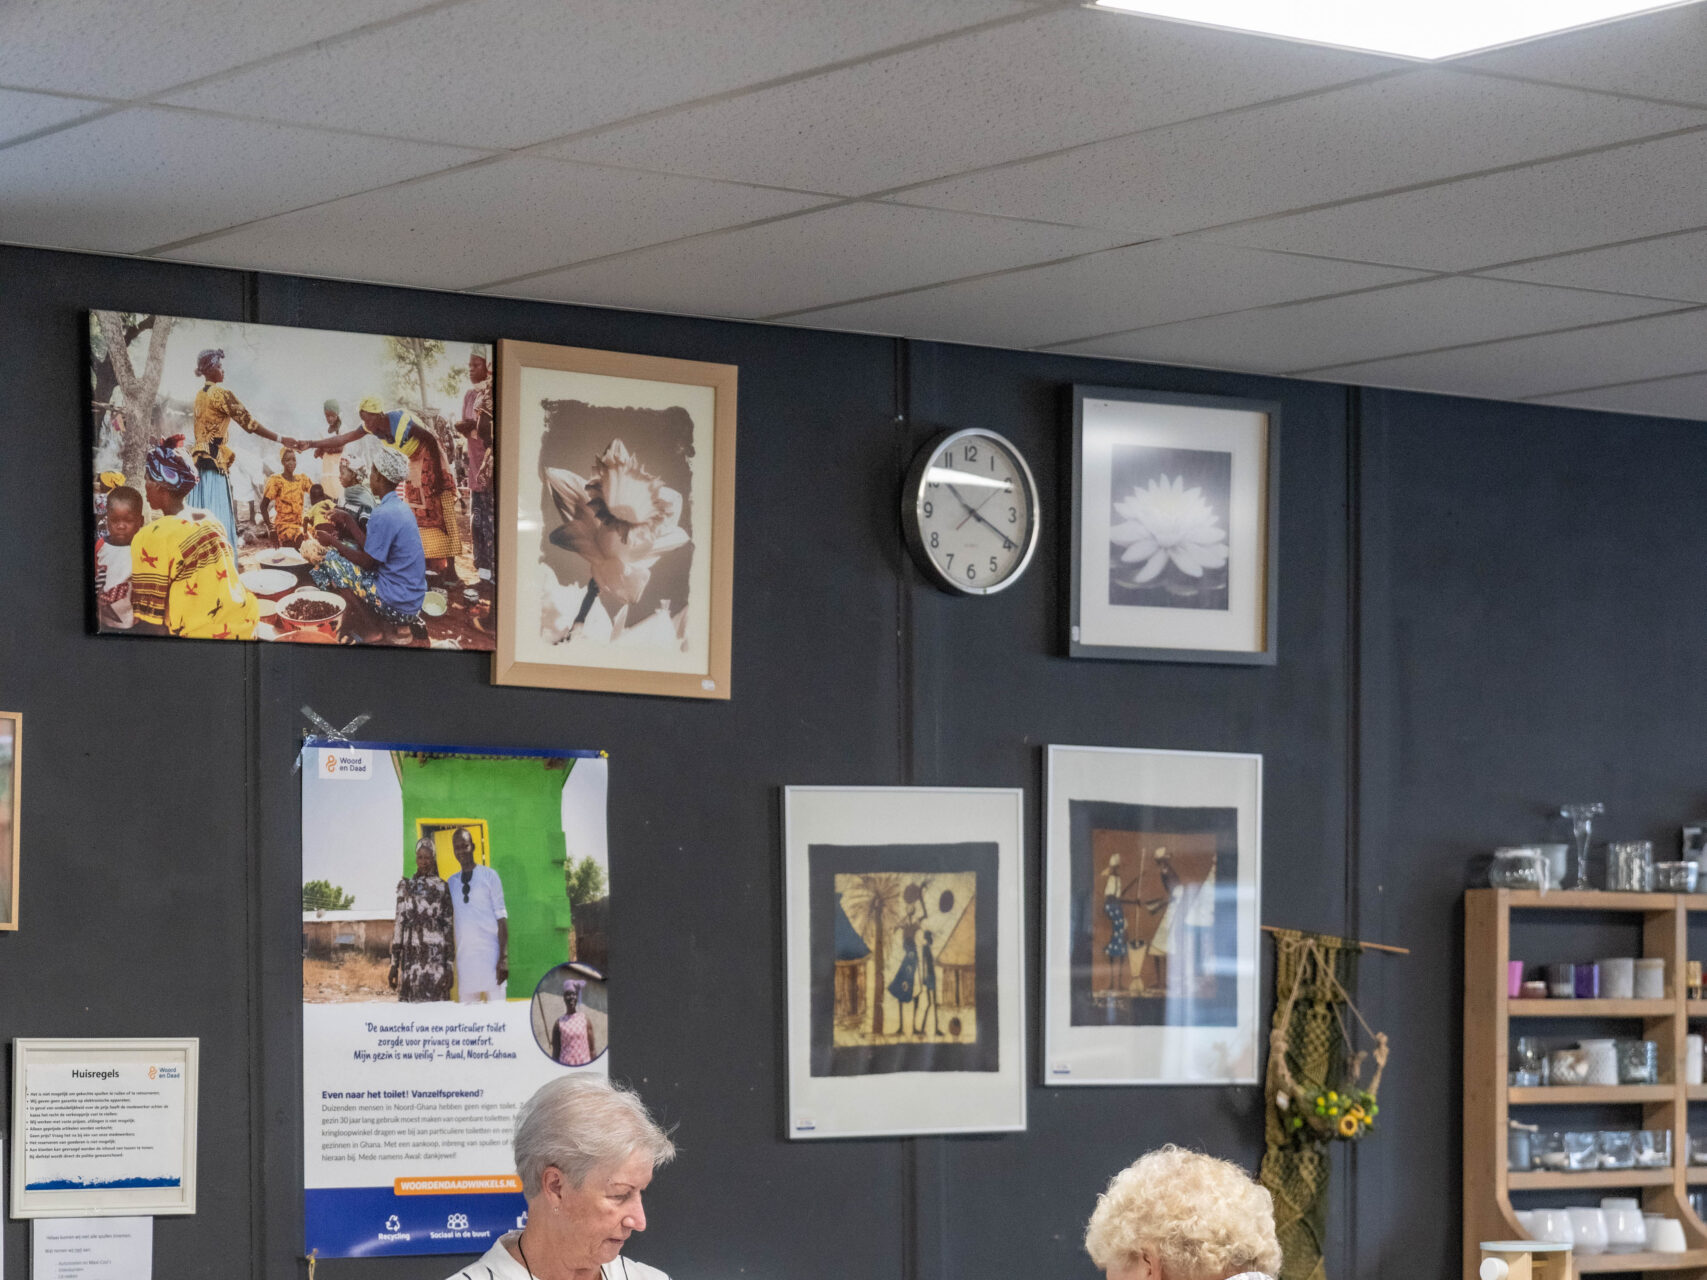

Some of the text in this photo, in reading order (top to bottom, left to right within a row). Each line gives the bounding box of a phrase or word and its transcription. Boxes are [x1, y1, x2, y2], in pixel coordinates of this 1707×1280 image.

[944, 452, 953, 468] 11
[964, 446, 978, 462] 12
[991, 456, 994, 471] 1
[924, 501, 933, 518] 9
[1008, 507, 1017, 523] 3
[930, 532, 939, 548] 8
[946, 553, 955, 570] 7
[989, 556, 998, 572] 5
[966, 564, 976, 579] 6
[340, 757, 362, 765] Woord
[380, 1022, 415, 1033] aanschaf
[445, 1022, 484, 1034] particulier
[486, 1022, 506, 1032] toilet
[378, 1036, 403, 1048] zorgde
[405, 1038, 421, 1046] voor
[422, 1037, 450, 1048] privacy
[462, 1036, 494, 1046] comfort.
[353, 1050, 371, 1062] Mijn
[372, 1051, 393, 1062] gezin
[395, 1051, 401, 1059] is
[445, 1050, 465, 1060] Awal,
[71, 1069, 120, 1080] Huisregels
[322, 1091, 343, 1099] Even
[367, 1090, 381, 1099] het
[383, 1090, 409, 1099] toilet!
[411, 1089, 484, 1099] Vanzelfsprekend?
[400, 1179, 517, 1191] WOORDENDAADWINKELS.NL
[378, 1233, 411, 1241] Recycling
[430, 1231, 453, 1239] Sociaal
[472, 1230, 490, 1238] buurt
